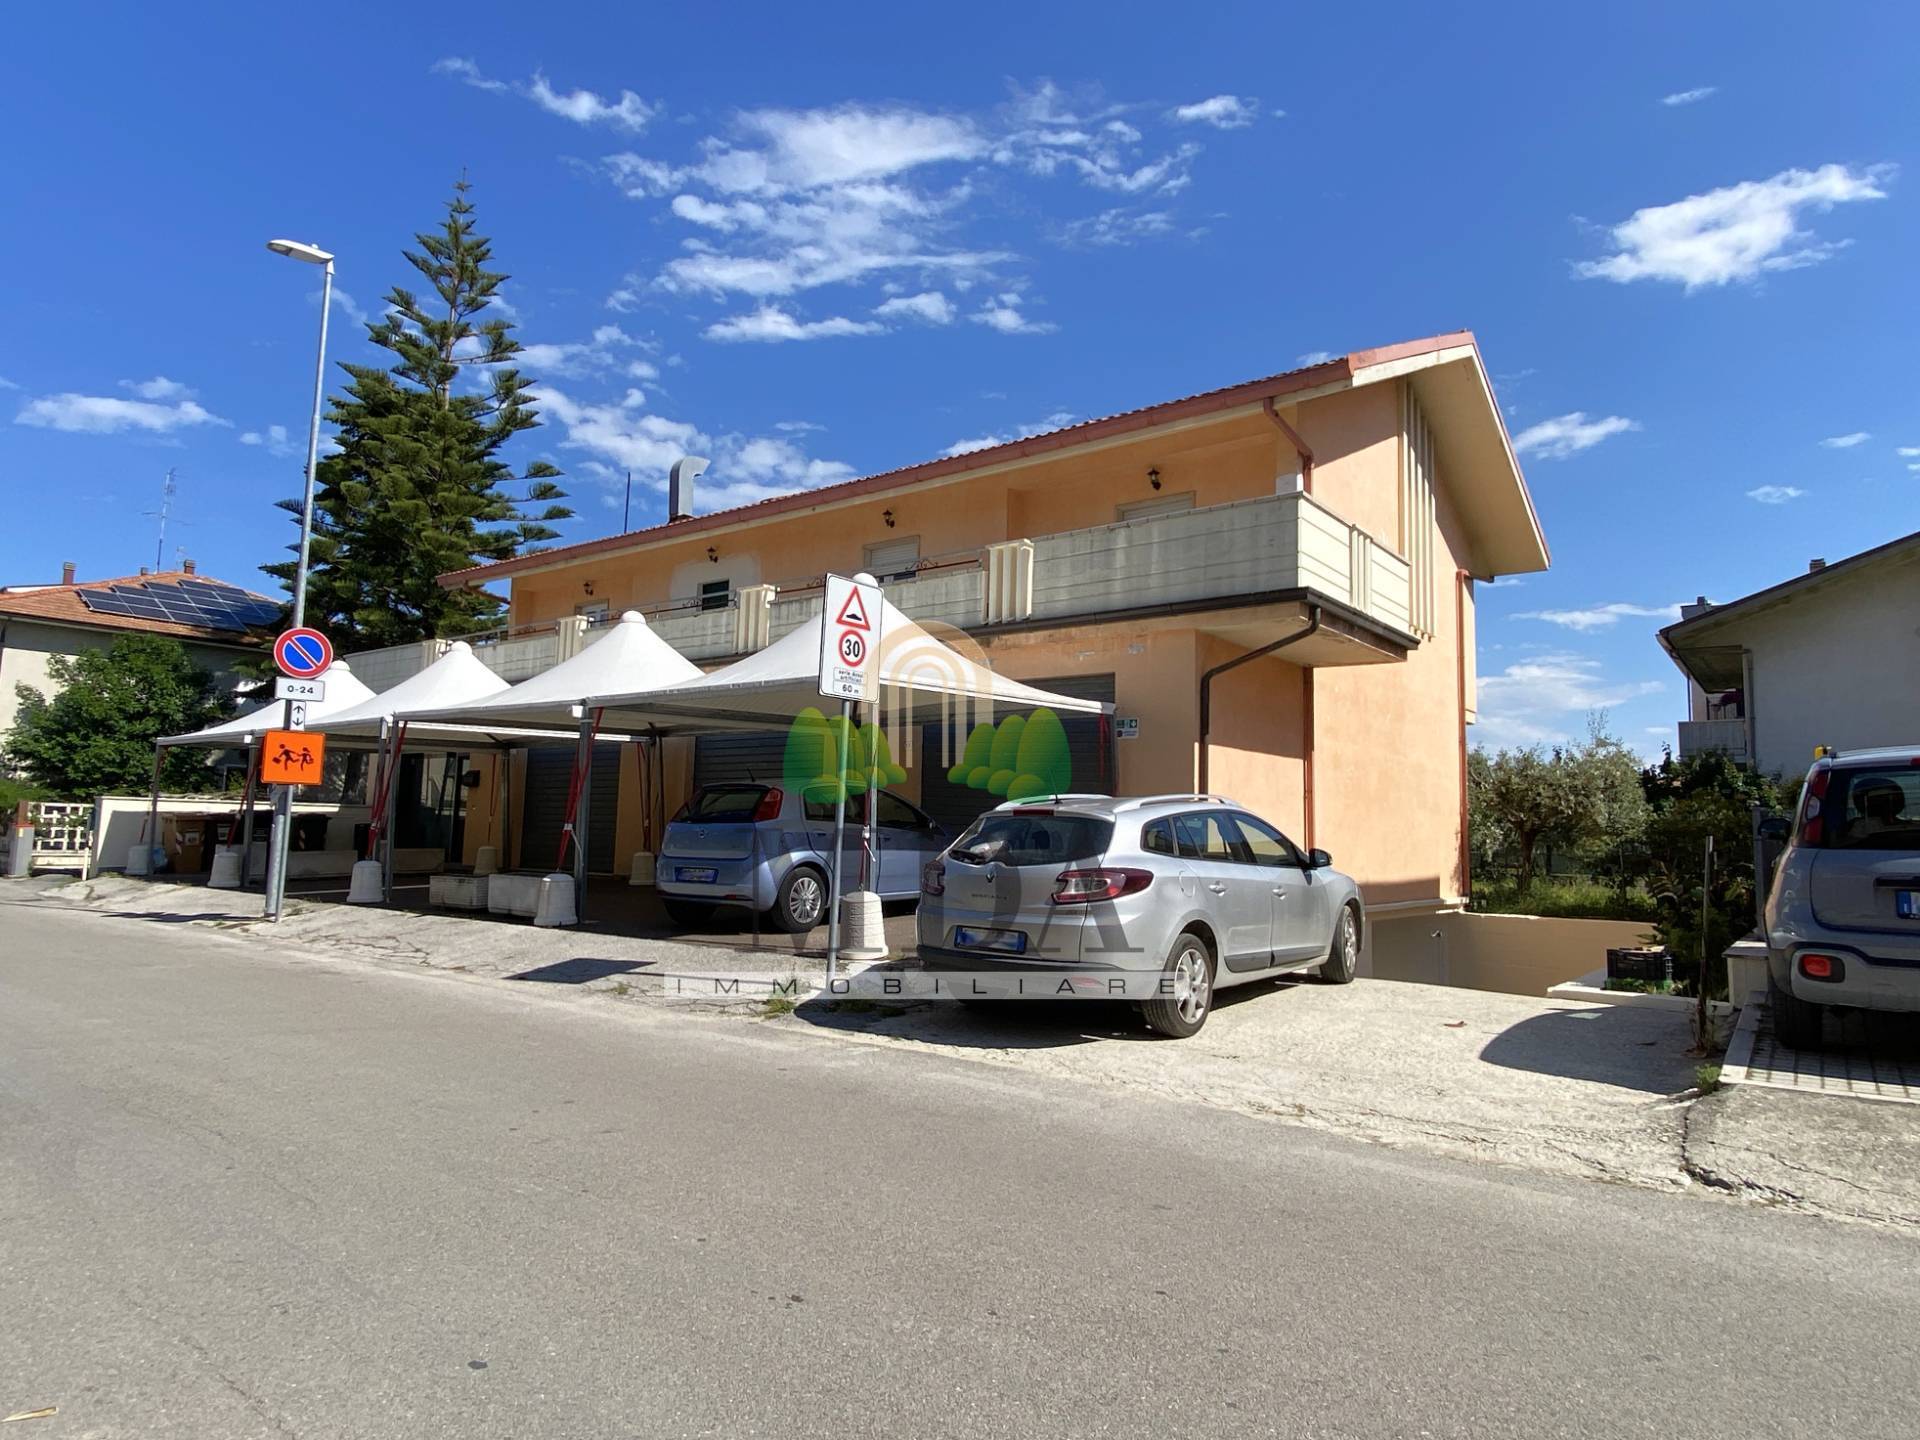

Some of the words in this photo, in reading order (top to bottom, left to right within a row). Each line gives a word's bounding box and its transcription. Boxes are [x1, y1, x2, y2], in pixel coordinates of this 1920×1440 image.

[844, 638, 861, 658] 30
[287, 685, 314, 694] 0-24
[842, 684, 853, 693] 60
